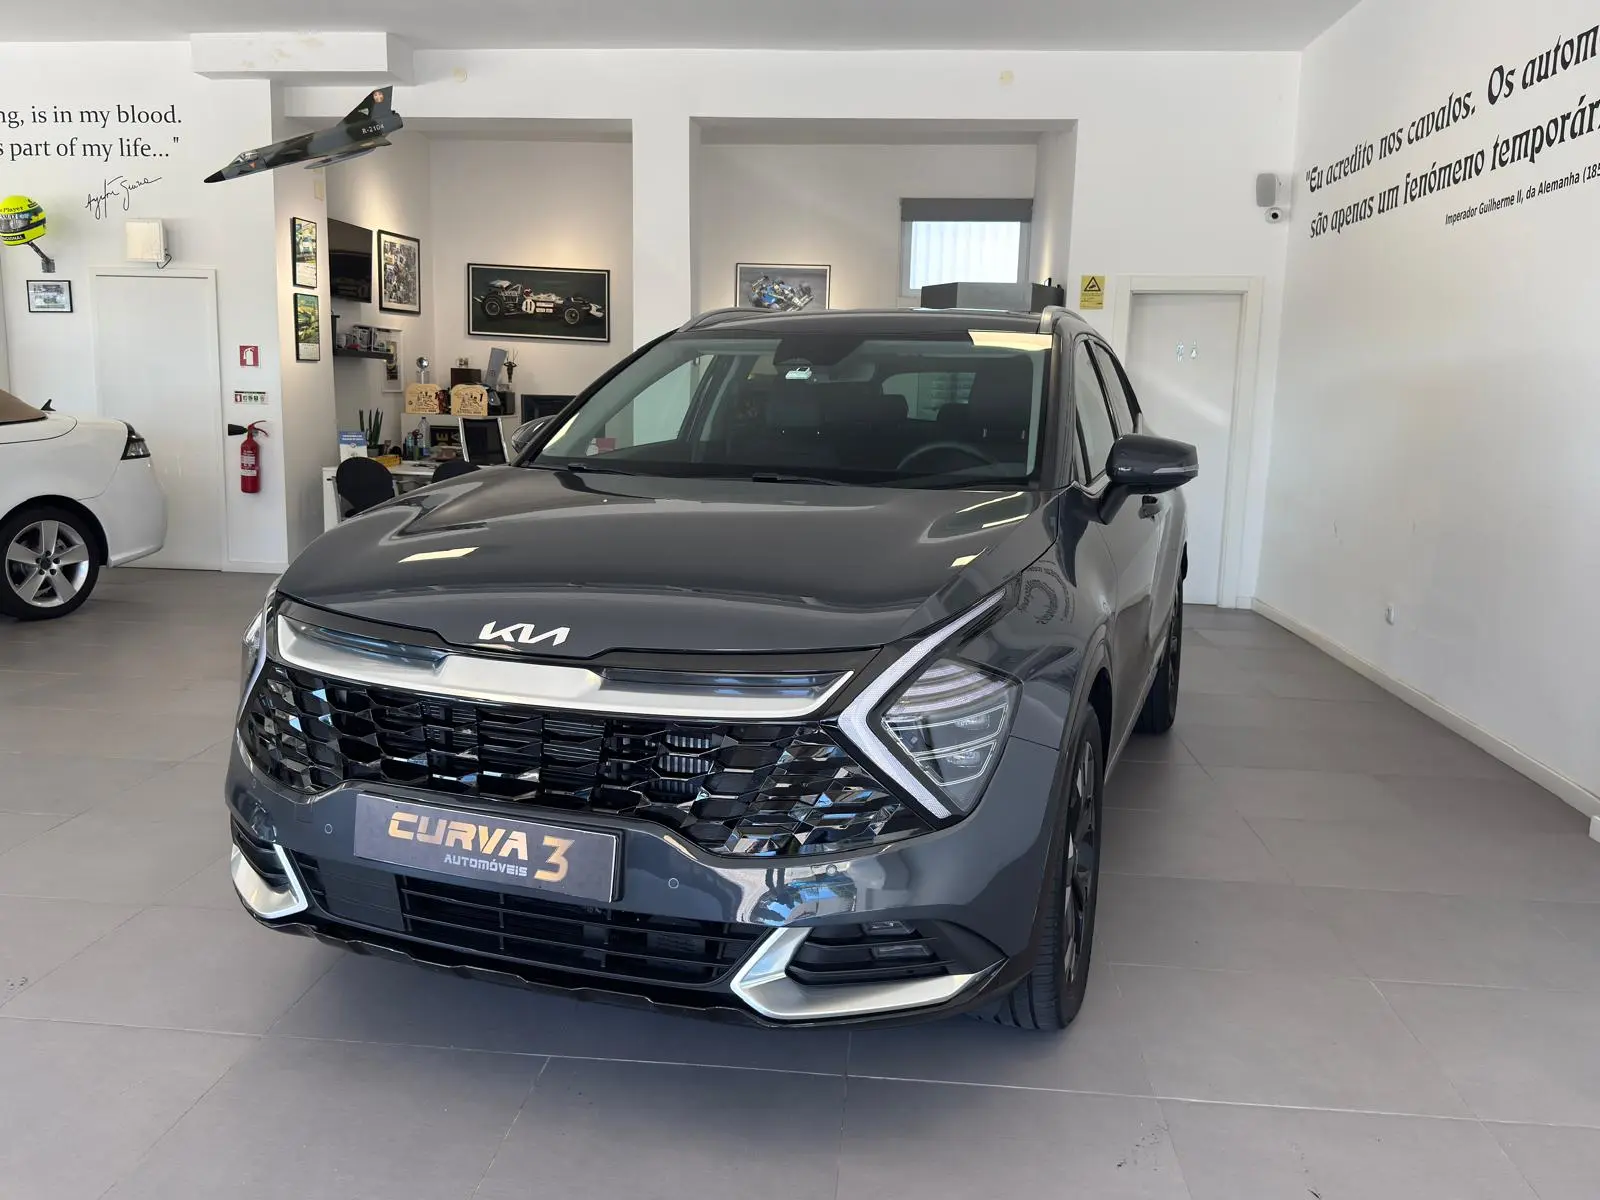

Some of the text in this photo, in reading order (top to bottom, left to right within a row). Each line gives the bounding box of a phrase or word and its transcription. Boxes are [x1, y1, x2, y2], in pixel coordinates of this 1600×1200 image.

[31, 104, 47, 123] is
[53, 104, 73, 123] in
[79, 110, 111, 129] my
[115, 104, 182, 124] blood.
[1326, 140, 1374, 186] acredito
[1378, 127, 1404, 161] nos
[1407, 91, 1476, 145] cavalos.
[1487, 64, 1516, 106] Os
[9, 140, 51, 162] part
[57, 136, 78, 157] of
[83, 143, 113, 162] my
[1310, 94, 1600, 239] são apenas um fenómeno temporár
[1444, 205, 1478, 225] Imperador
[1478, 194, 1515, 215] Guilherme
[1525, 185, 1536, 200] da
[1537, 171, 1580, 196] Alemanha
[387, 811, 575, 882] CURVA 3
[443, 853, 528, 877] AUTOMÓVEIS
